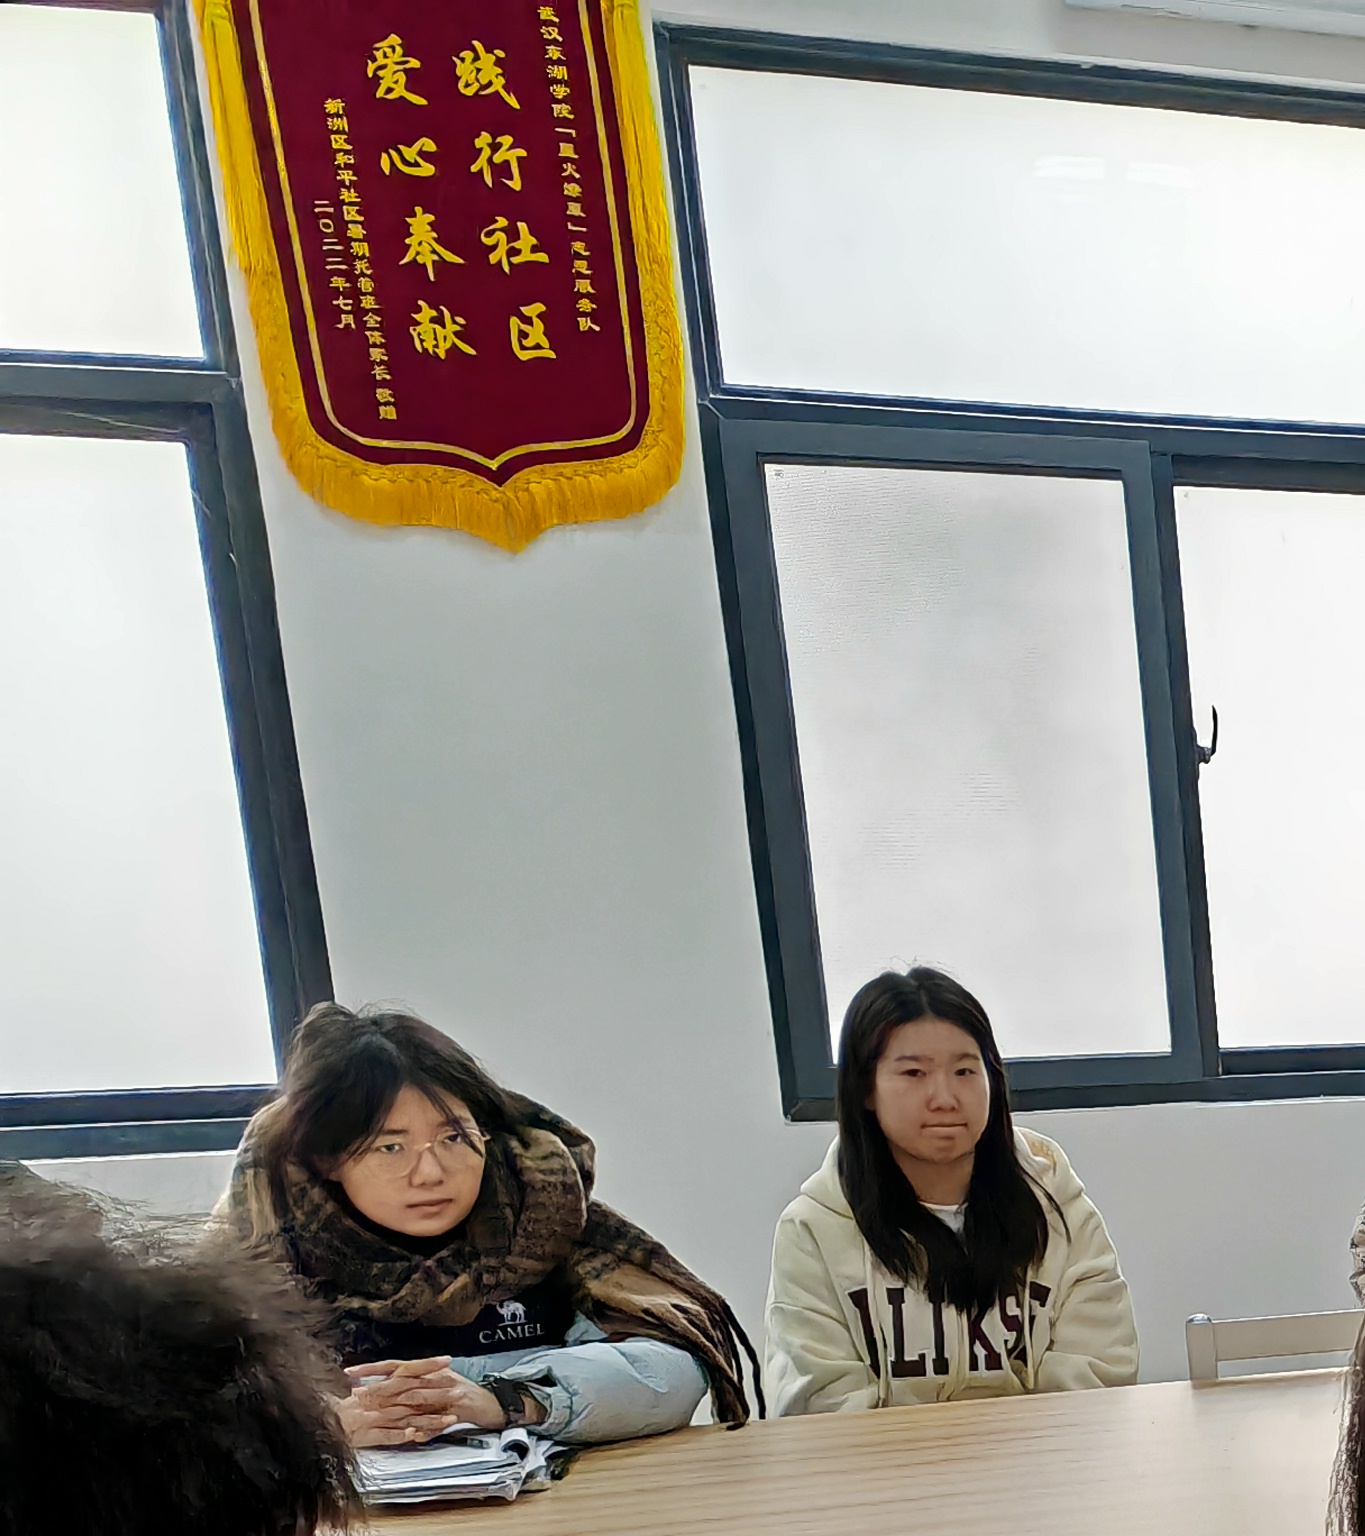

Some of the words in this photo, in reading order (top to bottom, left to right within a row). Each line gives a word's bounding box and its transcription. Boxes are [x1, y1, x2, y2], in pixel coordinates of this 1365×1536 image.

[366, 33, 478, 361] 爱心奉献
[452, 40, 557, 361] 践行社区
[479, 1323, 545, 1344] CAMEL
